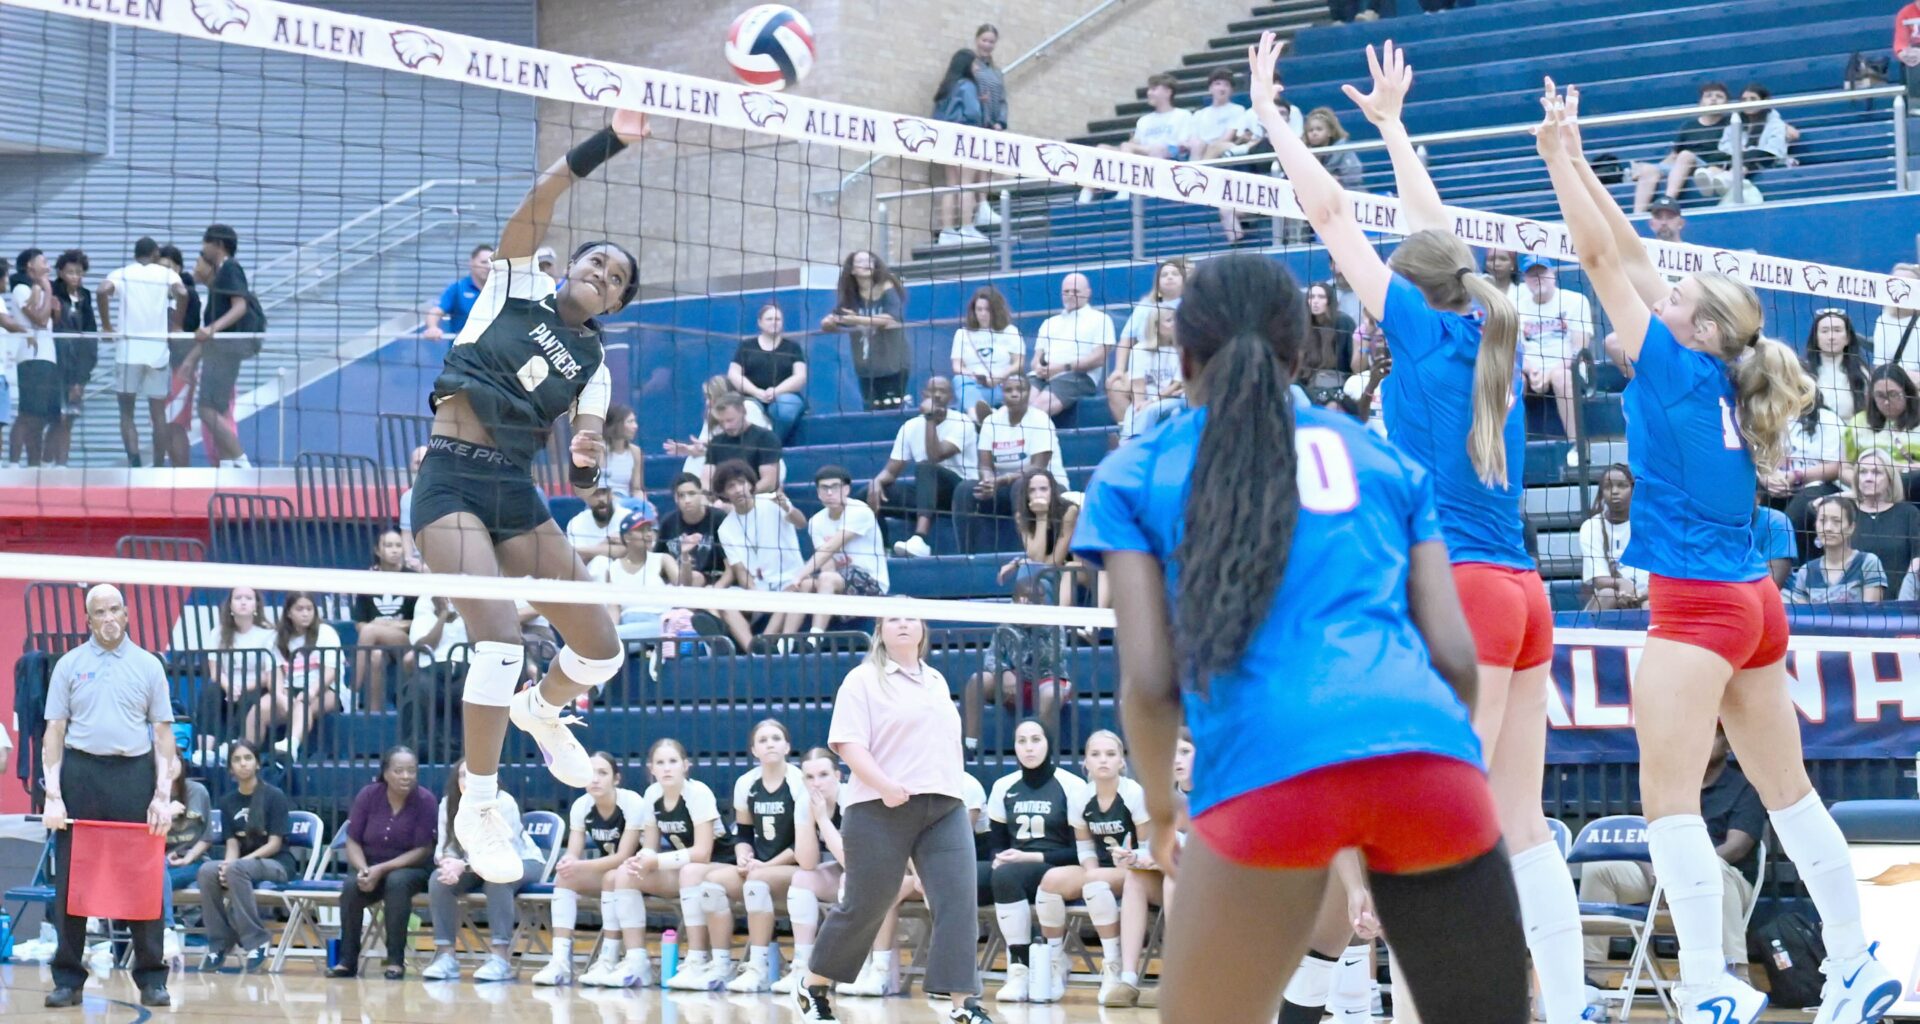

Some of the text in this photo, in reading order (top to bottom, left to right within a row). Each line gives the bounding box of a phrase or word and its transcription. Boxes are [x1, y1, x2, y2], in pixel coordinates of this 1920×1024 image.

[273, 17, 365, 56] ALLEN
[466, 52, 550, 89] ALLEN
[642, 81, 719, 116] ALLEN
[804, 111, 876, 143] ALLEN
[954, 135, 1021, 167] ALLEN
[1092, 159, 1155, 188] ALLEN
[1221, 180, 1279, 208] ALLEN
[1354, 202, 1397, 227] LLEN
[1454, 217, 1505, 243] ALLEN
[1658, 249, 1703, 272] ALLEN
[1750, 262, 1793, 286] ALLEN
[1837, 275, 1877, 298] ALLEN
[528, 322, 582, 380] PANTHERS
[428, 438, 472, 456] NIKE
[1013, 800, 1052, 814] PANTHERS
[527, 822, 553, 835] LEN
[762, 815, 776, 841] 5
[1015, 814, 1046, 840] 20
